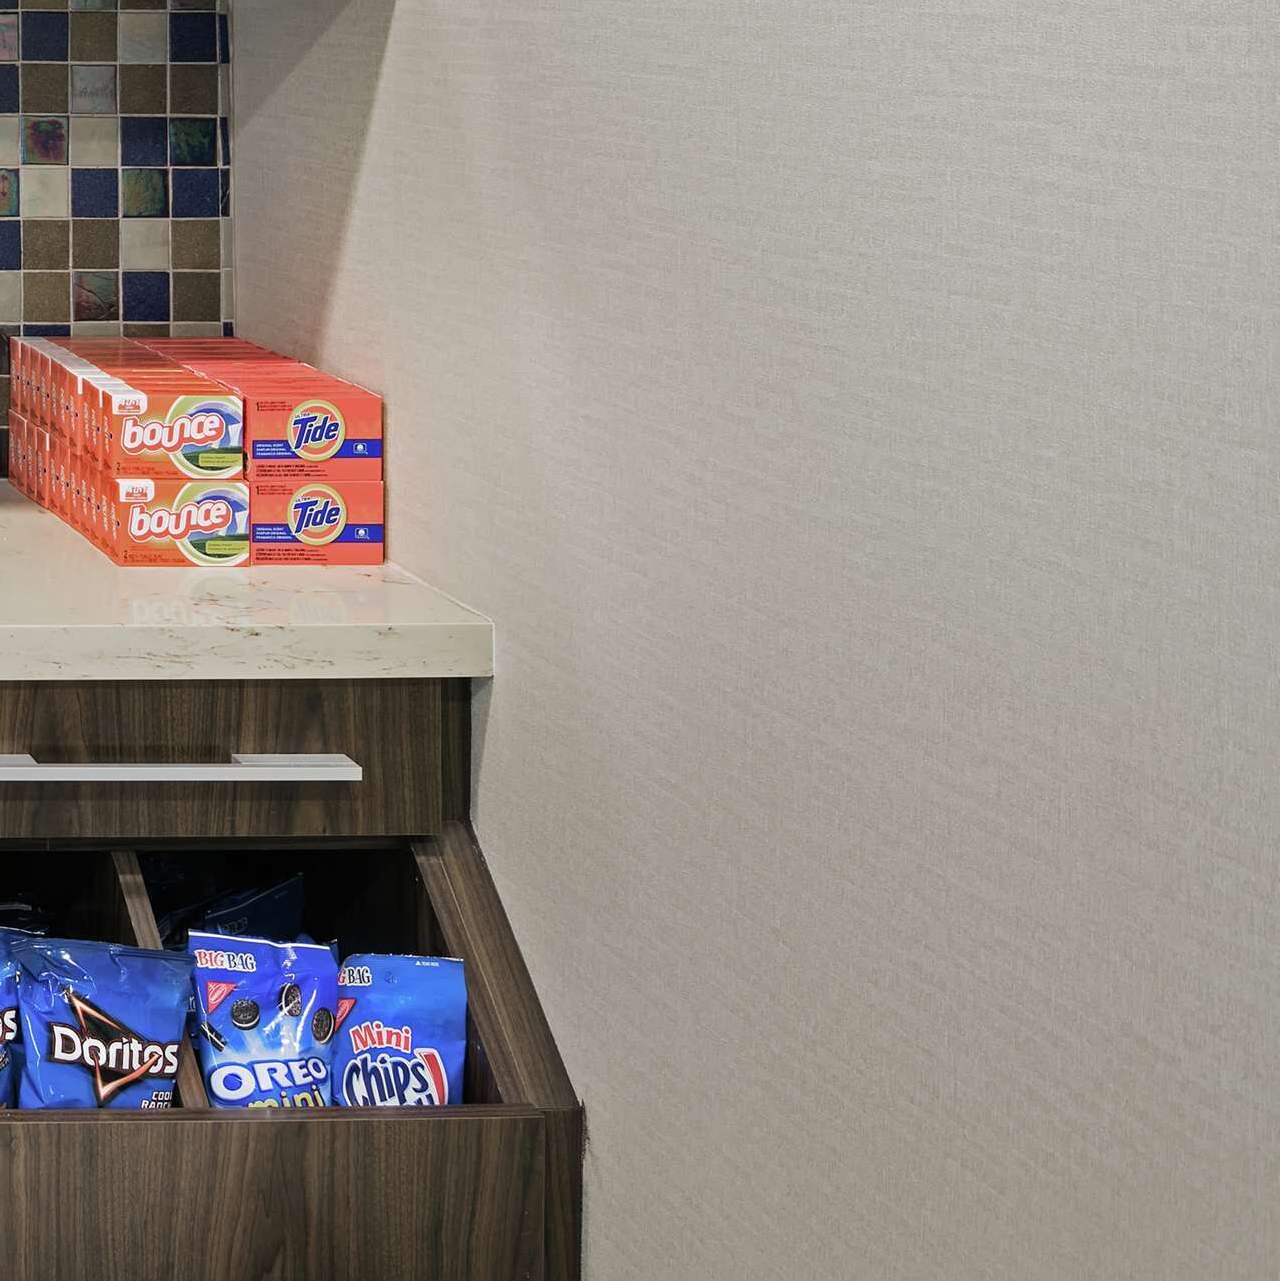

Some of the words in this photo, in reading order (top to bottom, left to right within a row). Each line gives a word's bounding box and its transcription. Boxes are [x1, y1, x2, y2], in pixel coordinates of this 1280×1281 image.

[123, 415, 220, 449] bounce
[292, 414, 340, 450] Tide
[131, 501, 227, 537] bounce
[293, 499, 341, 534] Tide
[195, 950, 225, 968] BIG
[226, 952, 257, 971] BAG
[347, 967, 372, 984] BAG
[52, 1023, 180, 1075] Doritos
[350, 1021, 413, 1053] Mini
[210, 1057, 328, 1102] OREO
[344, 1053, 429, 1107] Chips
